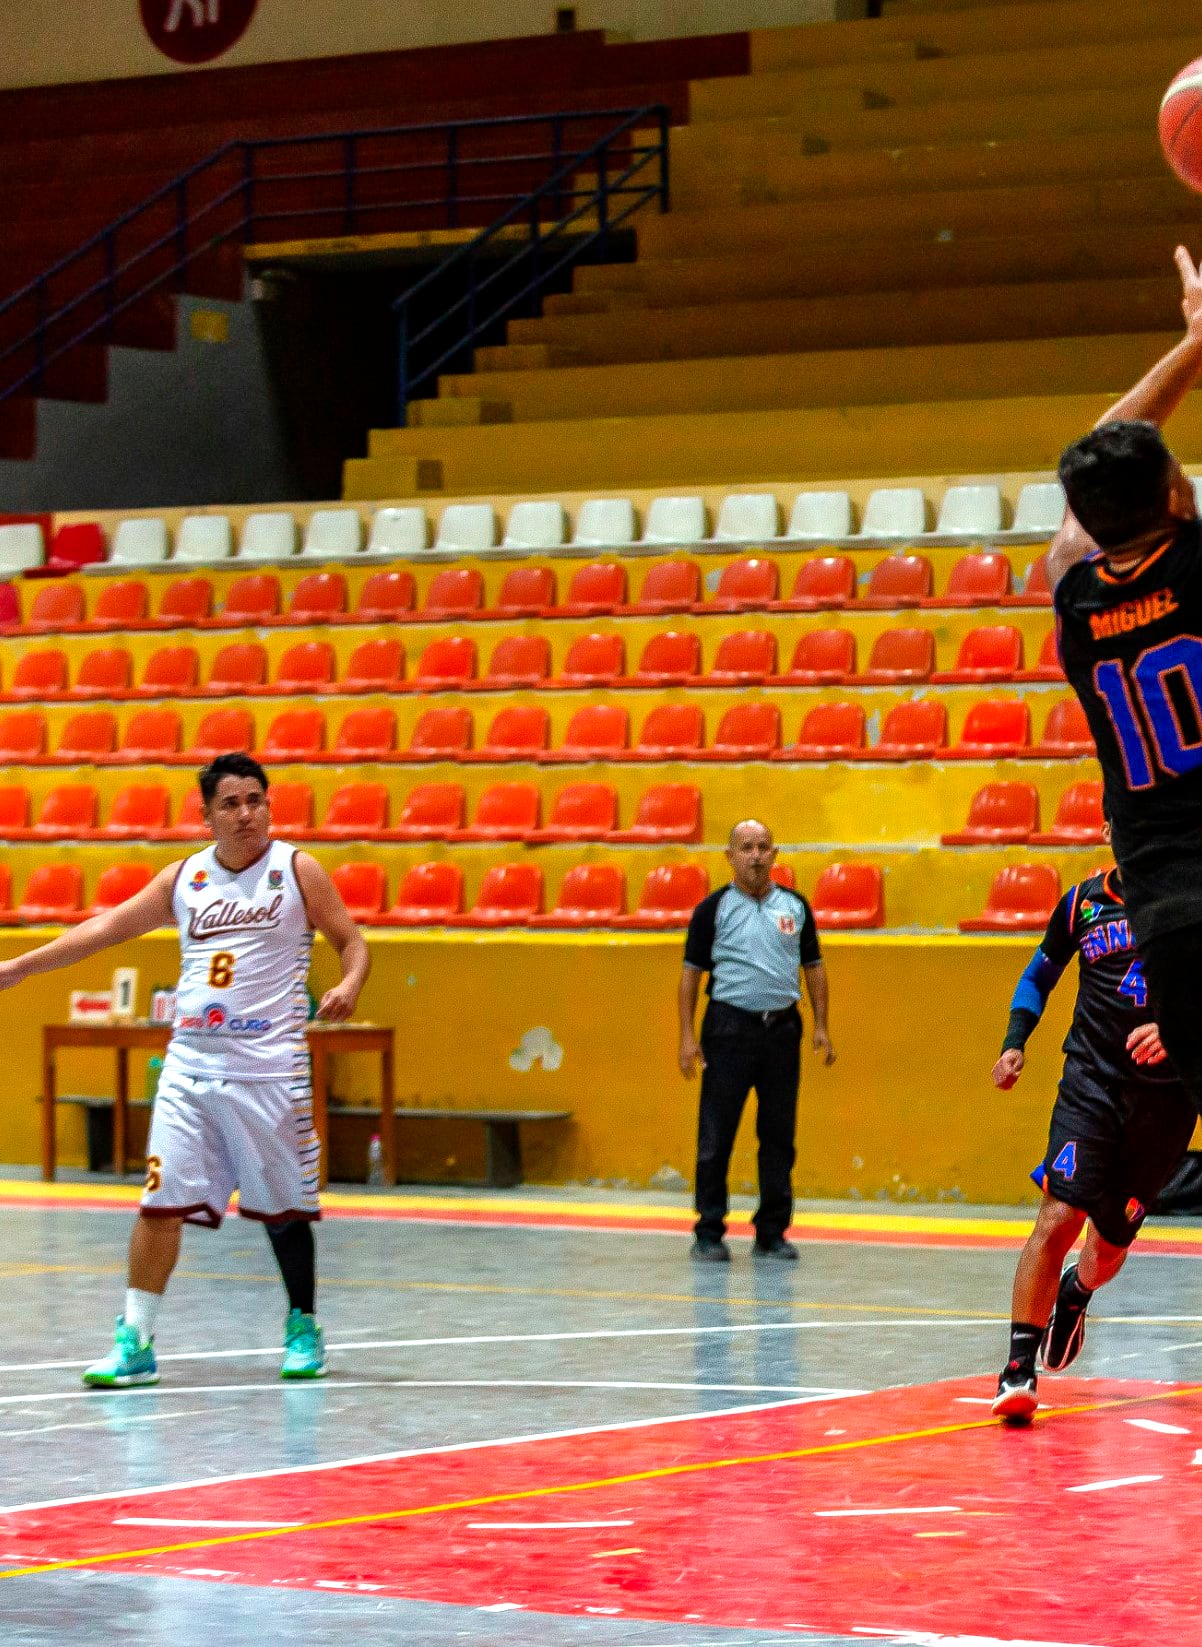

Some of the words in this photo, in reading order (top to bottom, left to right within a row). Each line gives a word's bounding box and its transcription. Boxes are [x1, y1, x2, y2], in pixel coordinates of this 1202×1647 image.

[1089, 586, 1180, 640] MIGUEL
[188, 893, 283, 940] Vallesol
[1117, 957, 1148, 1007] 4
[1051, 1140, 1077, 1181] 4
